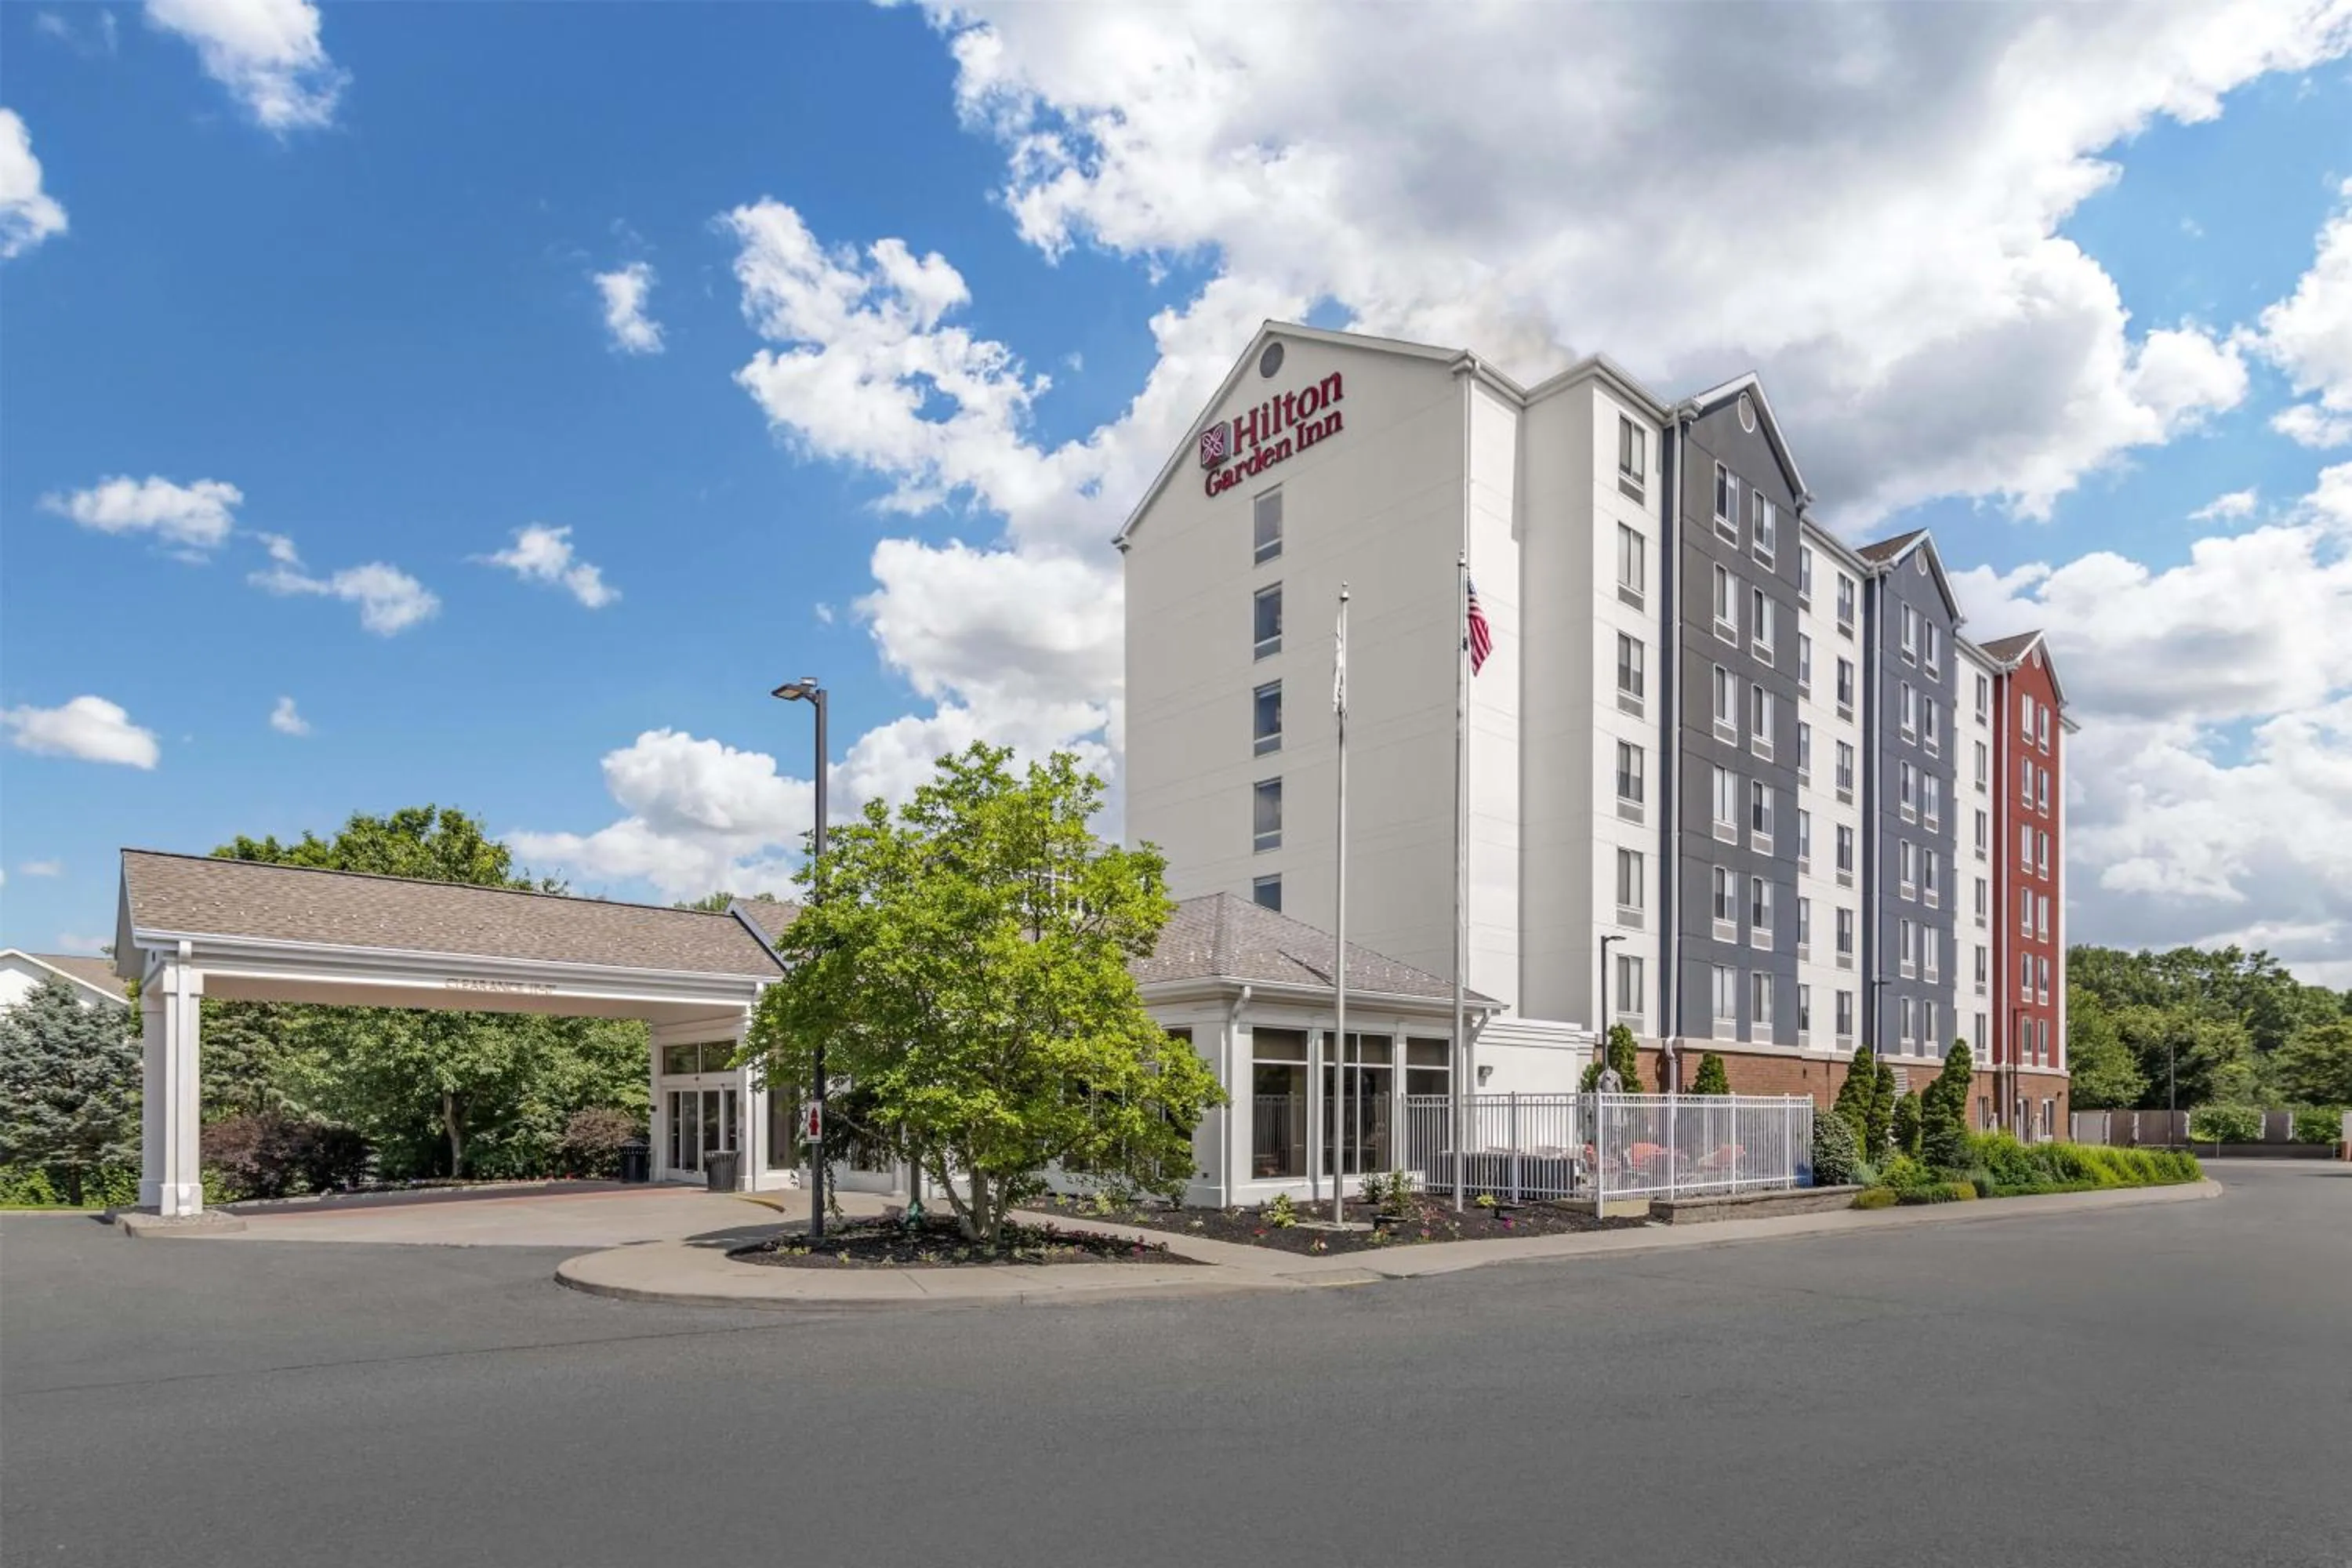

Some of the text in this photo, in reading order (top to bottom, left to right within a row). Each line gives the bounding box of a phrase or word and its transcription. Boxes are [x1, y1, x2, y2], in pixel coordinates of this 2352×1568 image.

[1205, 410, 1344, 498] Garden Inn
[1232, 371, 1344, 456] Hilton
